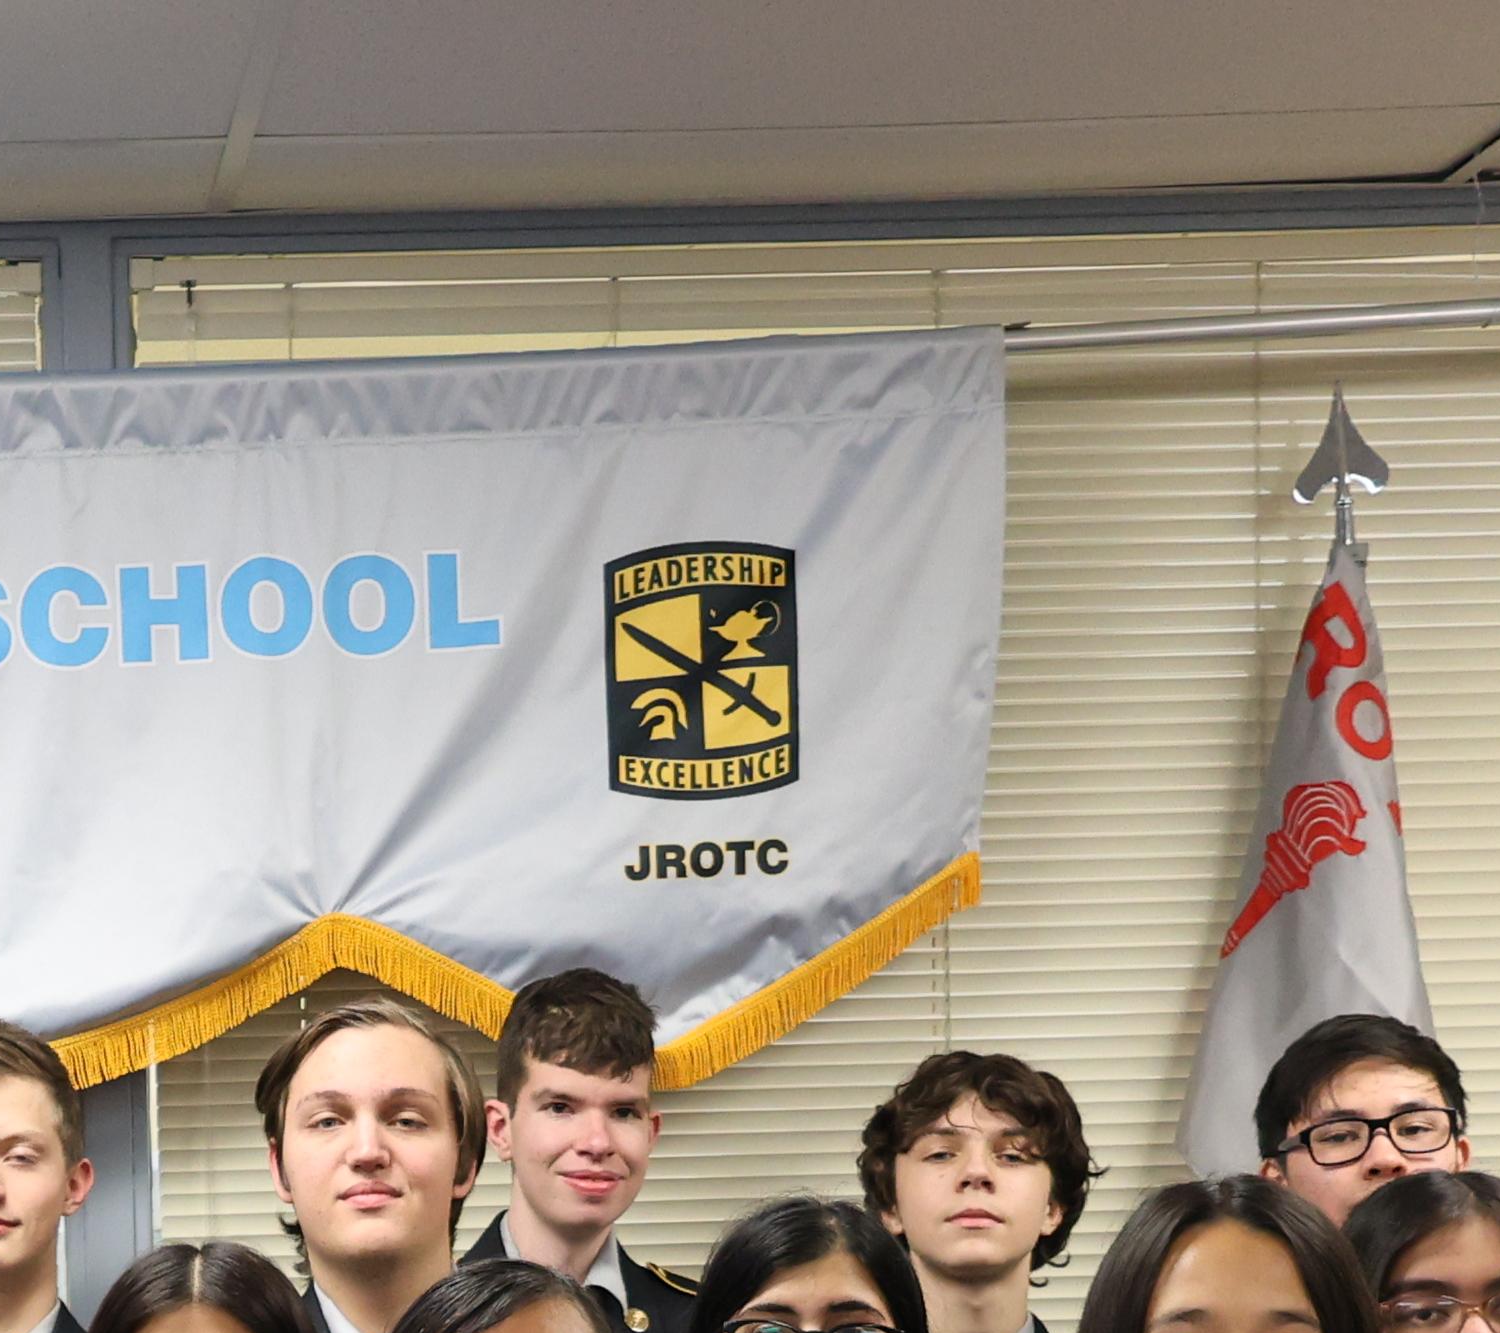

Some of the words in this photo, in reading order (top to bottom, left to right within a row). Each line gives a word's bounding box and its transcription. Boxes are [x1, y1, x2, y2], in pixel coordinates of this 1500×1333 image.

[619, 556, 784, 600] LEADERSHIP
[624, 748, 786, 790] EXCELLENCE
[624, 838, 789, 882] JROTC
